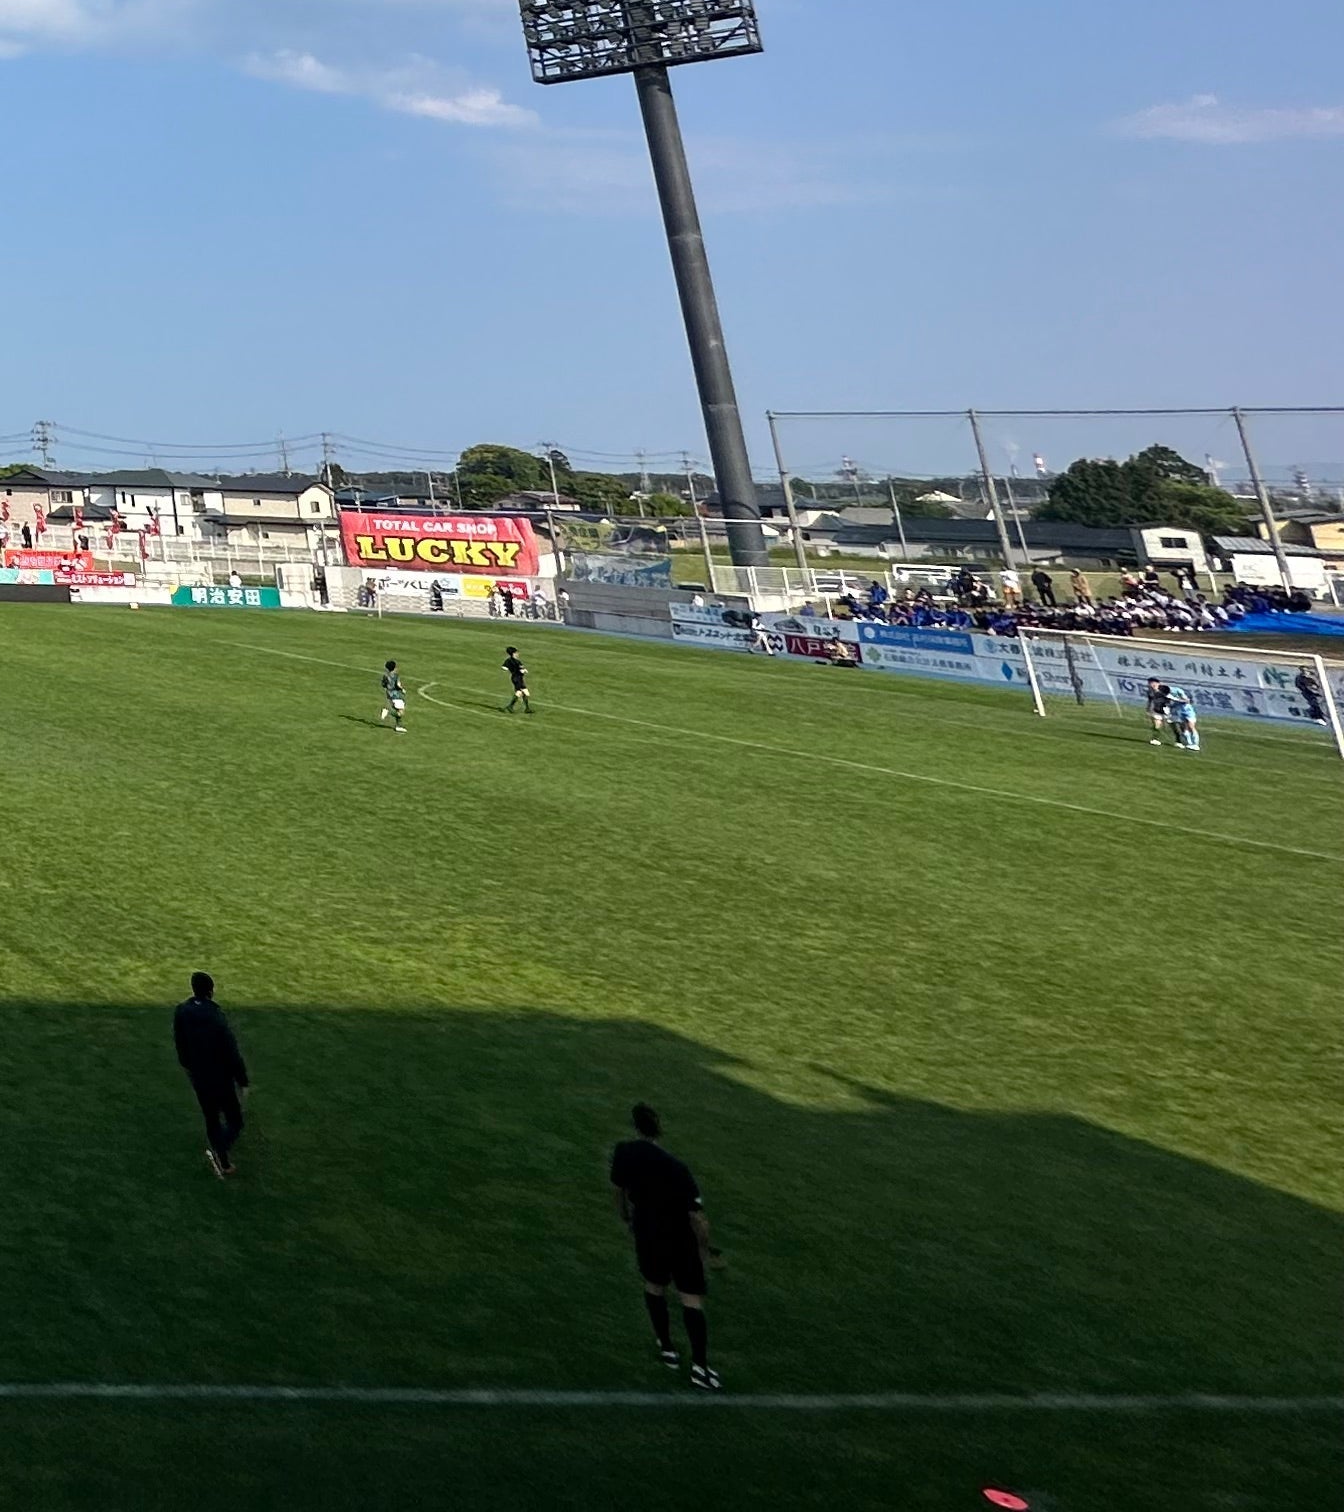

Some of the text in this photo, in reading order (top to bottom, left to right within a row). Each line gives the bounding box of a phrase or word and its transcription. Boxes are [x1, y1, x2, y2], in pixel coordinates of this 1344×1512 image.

[373, 519, 498, 536] TOTAL CAR SHOP
[357, 535, 522, 569] LUCKY
[192, 588, 262, 606] 明治安田
